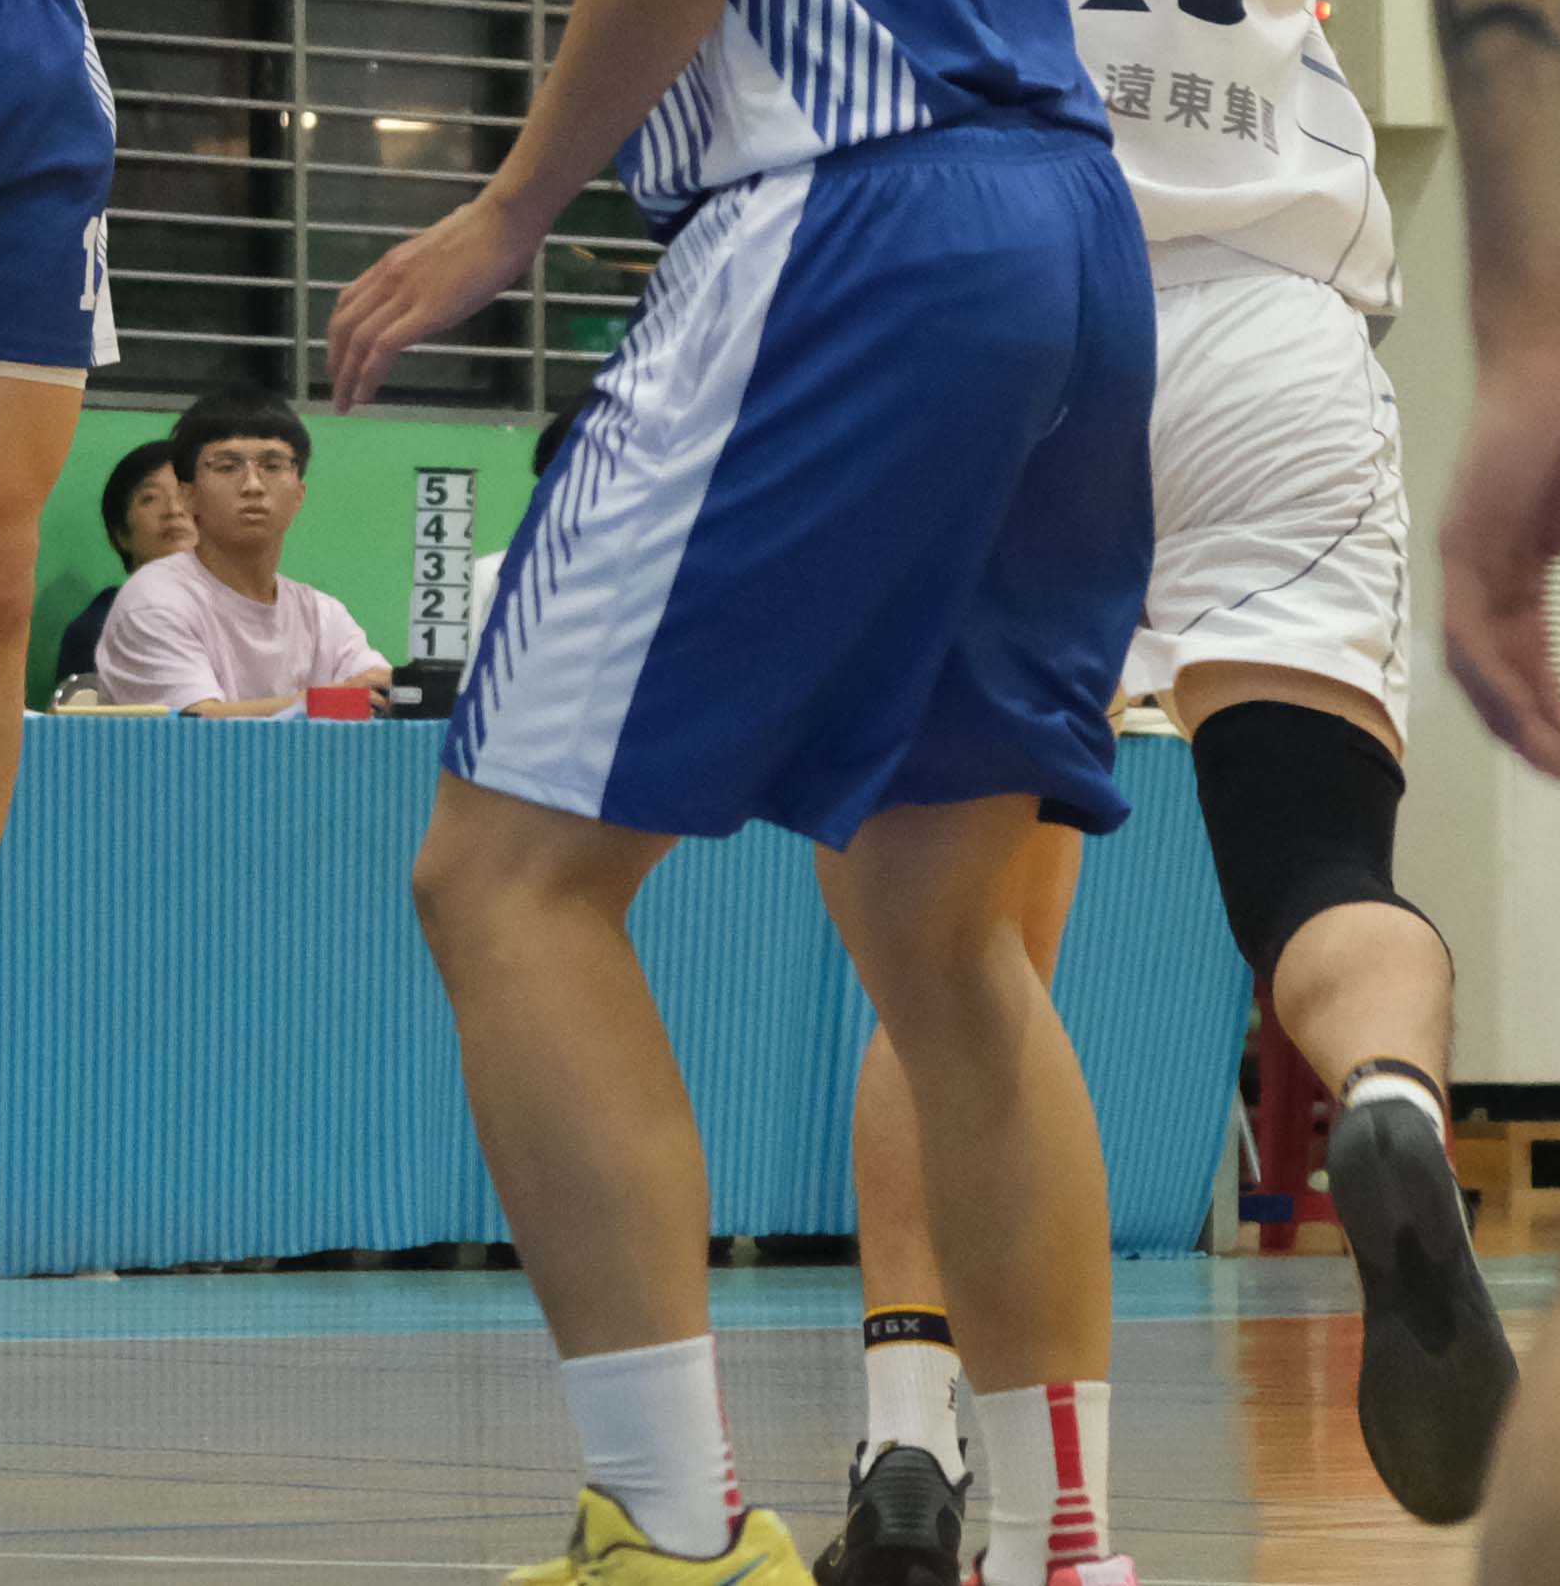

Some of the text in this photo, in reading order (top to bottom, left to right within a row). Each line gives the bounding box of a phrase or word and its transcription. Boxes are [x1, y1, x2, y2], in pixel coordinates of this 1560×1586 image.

[424, 476, 448, 506] 5
[422, 513, 448, 544] 4
[423, 551, 446, 582] 3
[421, 588, 445, 620] 2
[421, 626, 437, 657] 1
